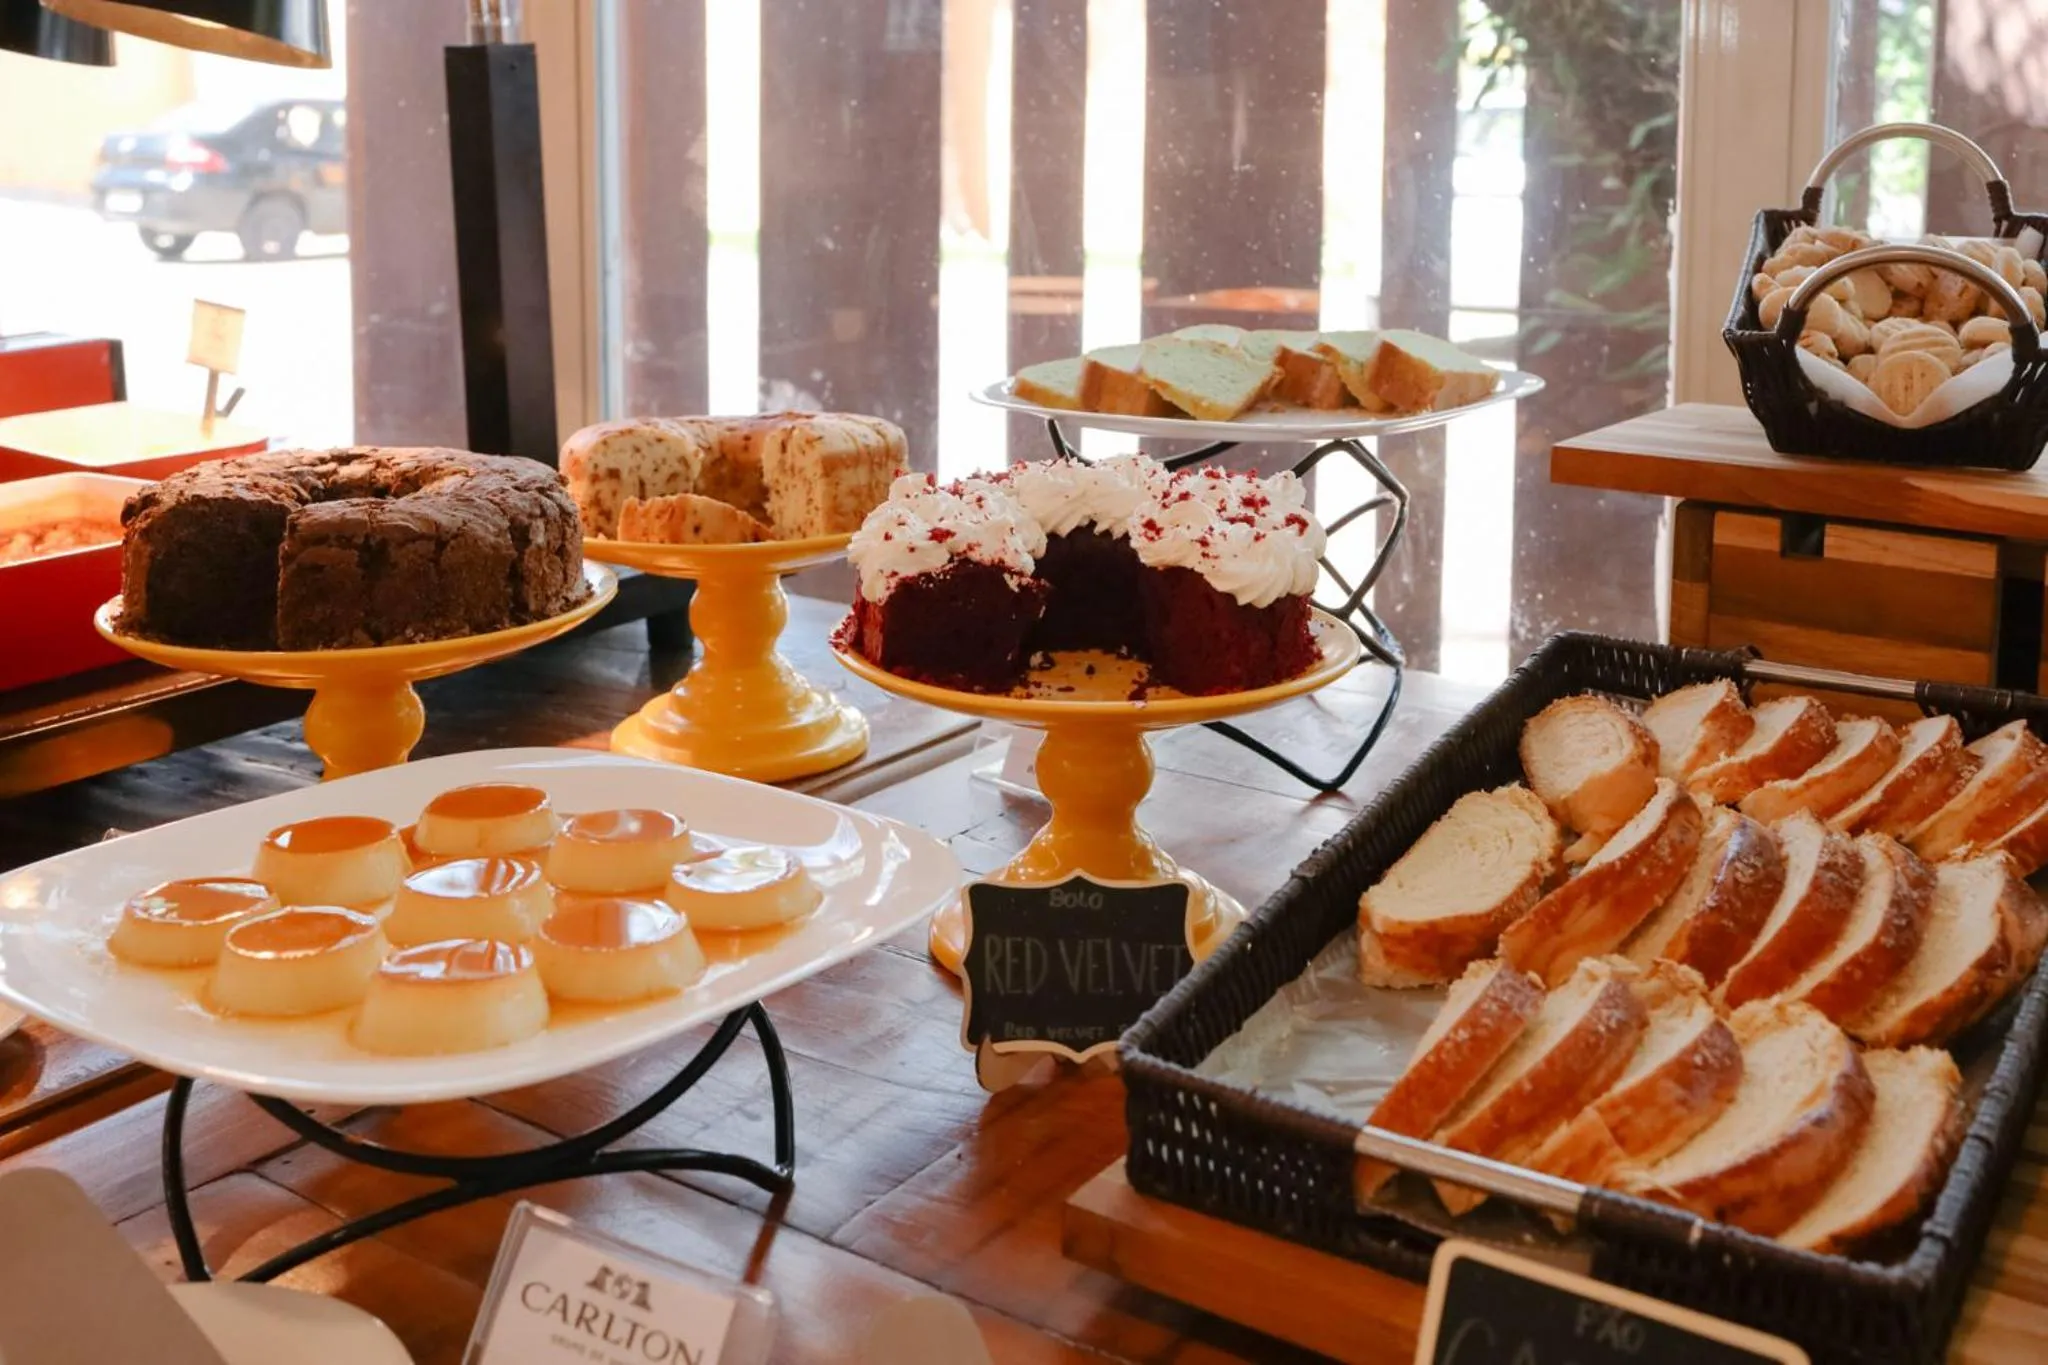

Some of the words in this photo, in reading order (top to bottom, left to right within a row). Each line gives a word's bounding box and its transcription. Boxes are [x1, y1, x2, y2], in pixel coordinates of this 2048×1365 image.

[984, 933, 1049, 996] RED
[1058, 937, 1186, 998] VELVET
[520, 1281, 704, 1365] CARLTON
